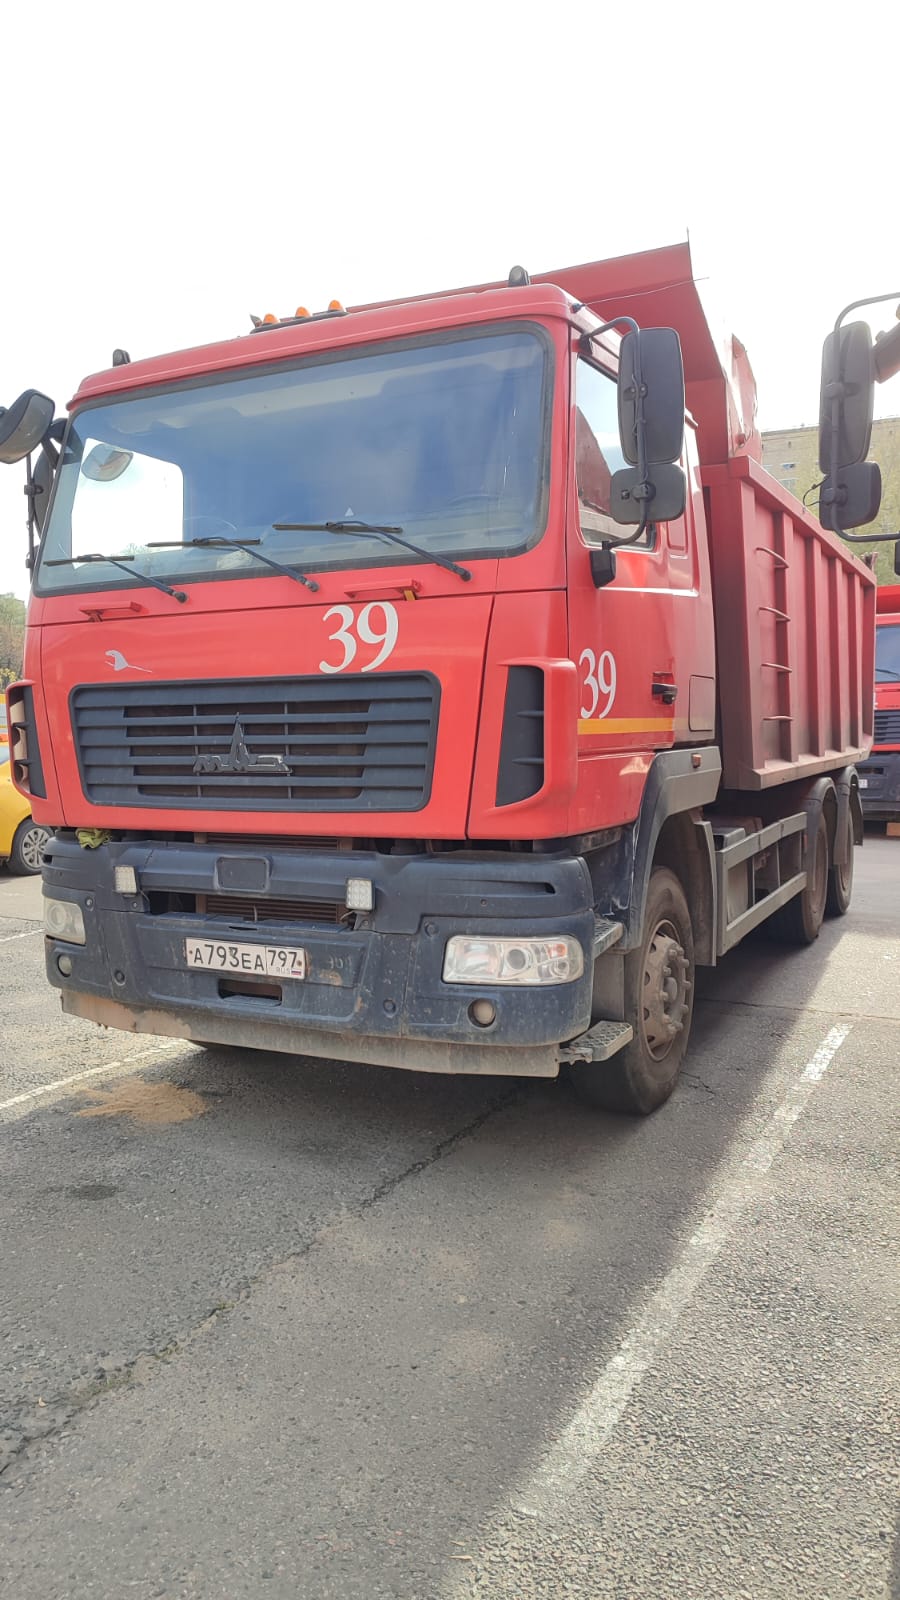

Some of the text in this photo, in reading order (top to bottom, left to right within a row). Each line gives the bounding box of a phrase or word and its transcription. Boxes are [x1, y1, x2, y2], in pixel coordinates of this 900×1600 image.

[319, 601, 399, 673] 39
[578, 648, 617, 719] 39
[193, 944, 298, 971] А793ЕА 797
[276, 967, 291, 975] RUS
